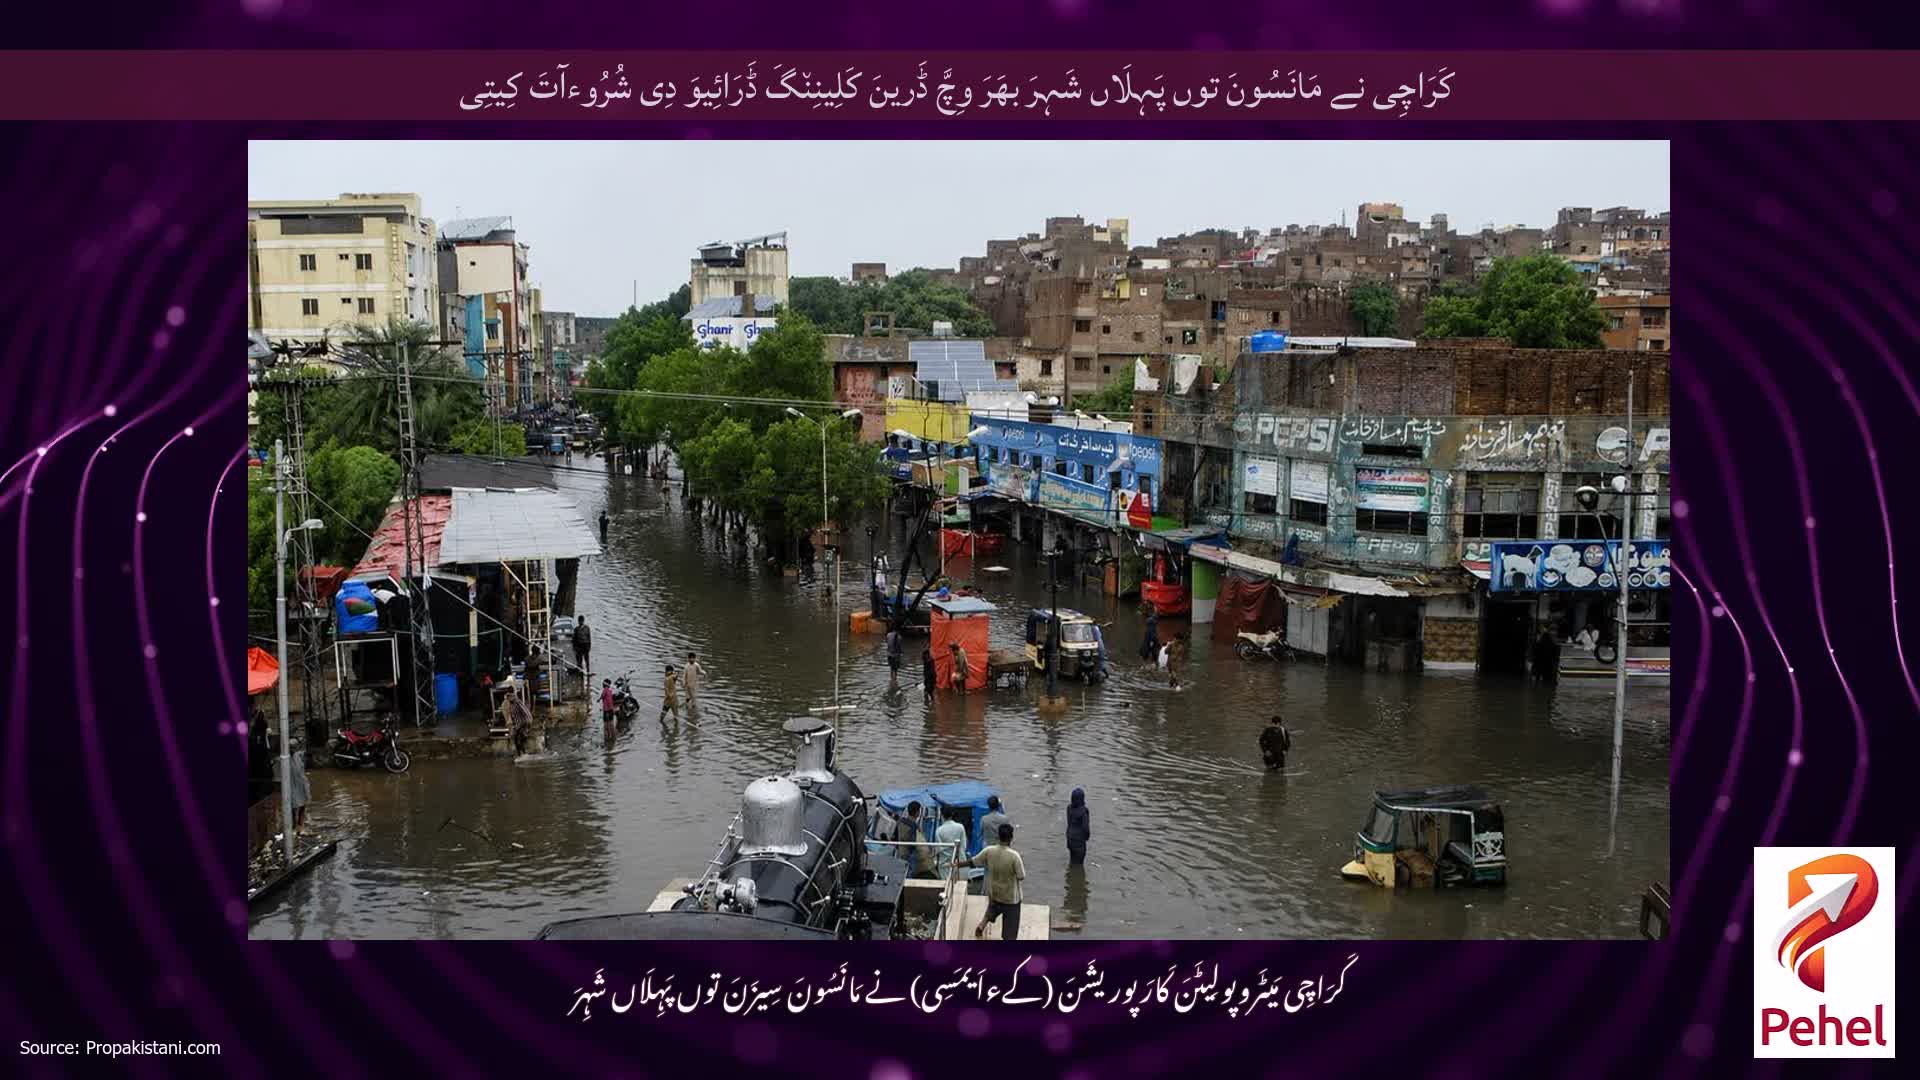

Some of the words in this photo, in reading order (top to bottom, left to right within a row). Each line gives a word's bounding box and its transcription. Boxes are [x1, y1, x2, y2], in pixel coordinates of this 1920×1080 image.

[697, 319, 734, 339] Ghani
[1255, 413, 1337, 454] PEPSI
[1367, 537, 1420, 556] PEPSI
